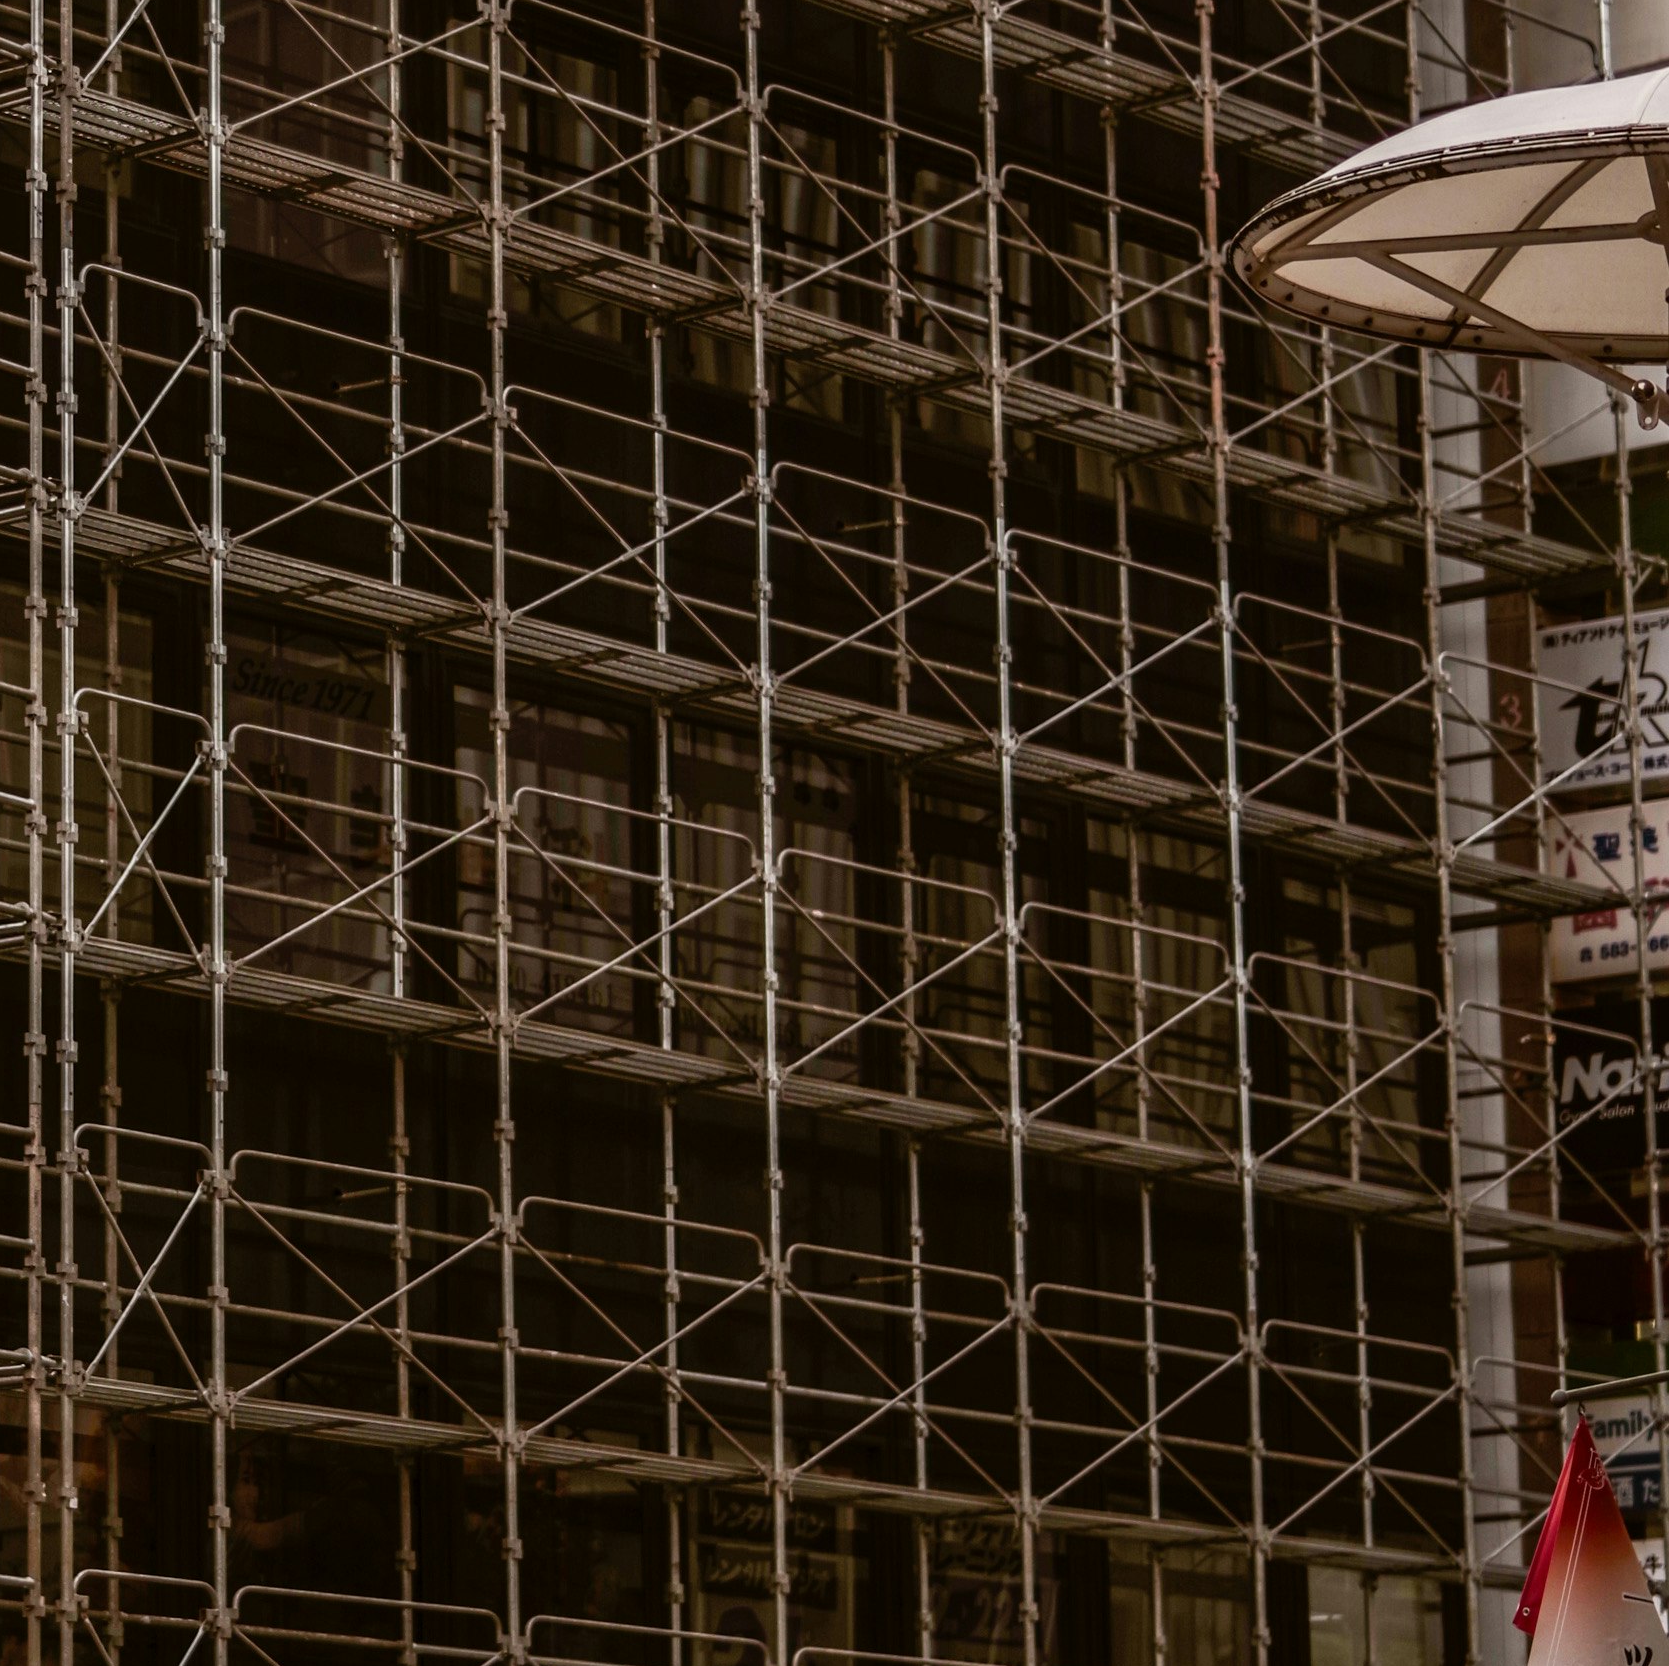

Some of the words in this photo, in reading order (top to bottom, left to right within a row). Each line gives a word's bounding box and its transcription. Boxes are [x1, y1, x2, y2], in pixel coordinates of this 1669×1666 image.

[233, 658, 309, 705] Since
[310, 678, 376, 722] 1971
[1498, 692, 1523, 731] 3
